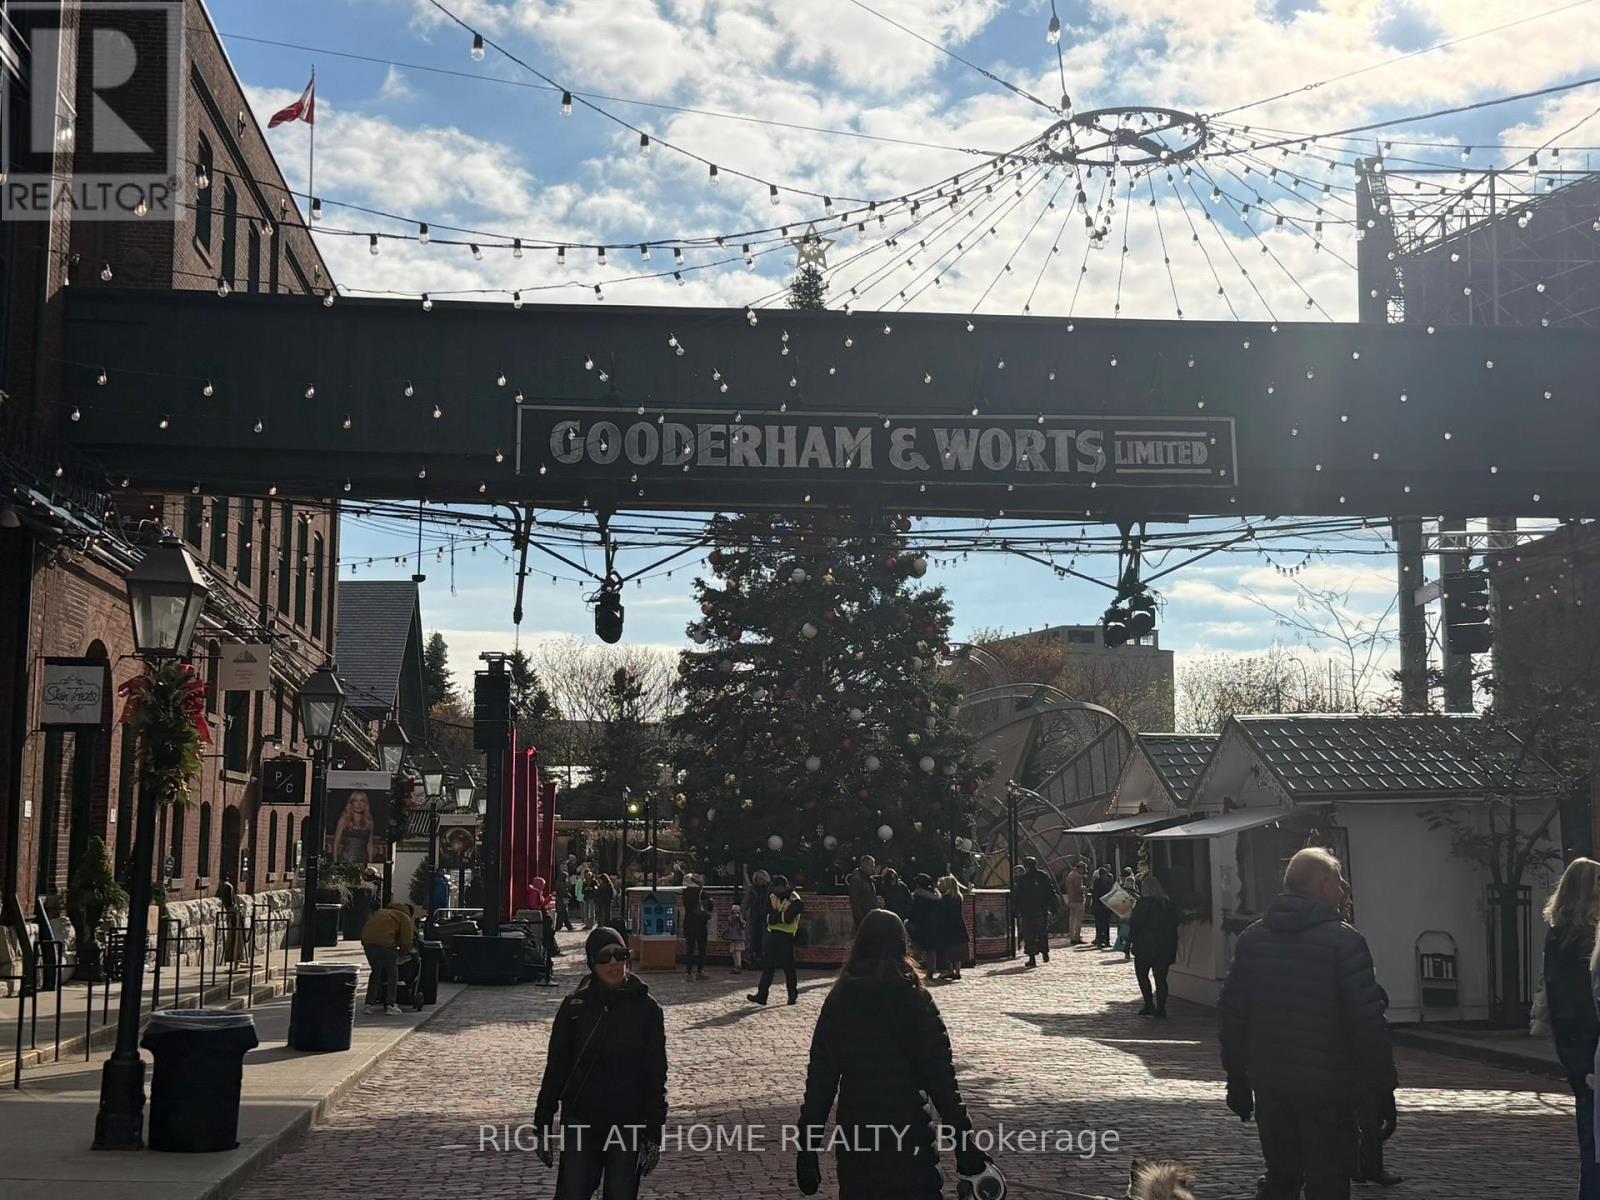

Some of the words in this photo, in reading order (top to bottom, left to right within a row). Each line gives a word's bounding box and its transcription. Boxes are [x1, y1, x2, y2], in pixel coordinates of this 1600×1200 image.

[550, 419, 874, 469] GOODERHAM
[889, 427, 931, 471] &
[933, 427, 1106, 473] WORTS
[1113, 440, 1208, 465] LIMITED
